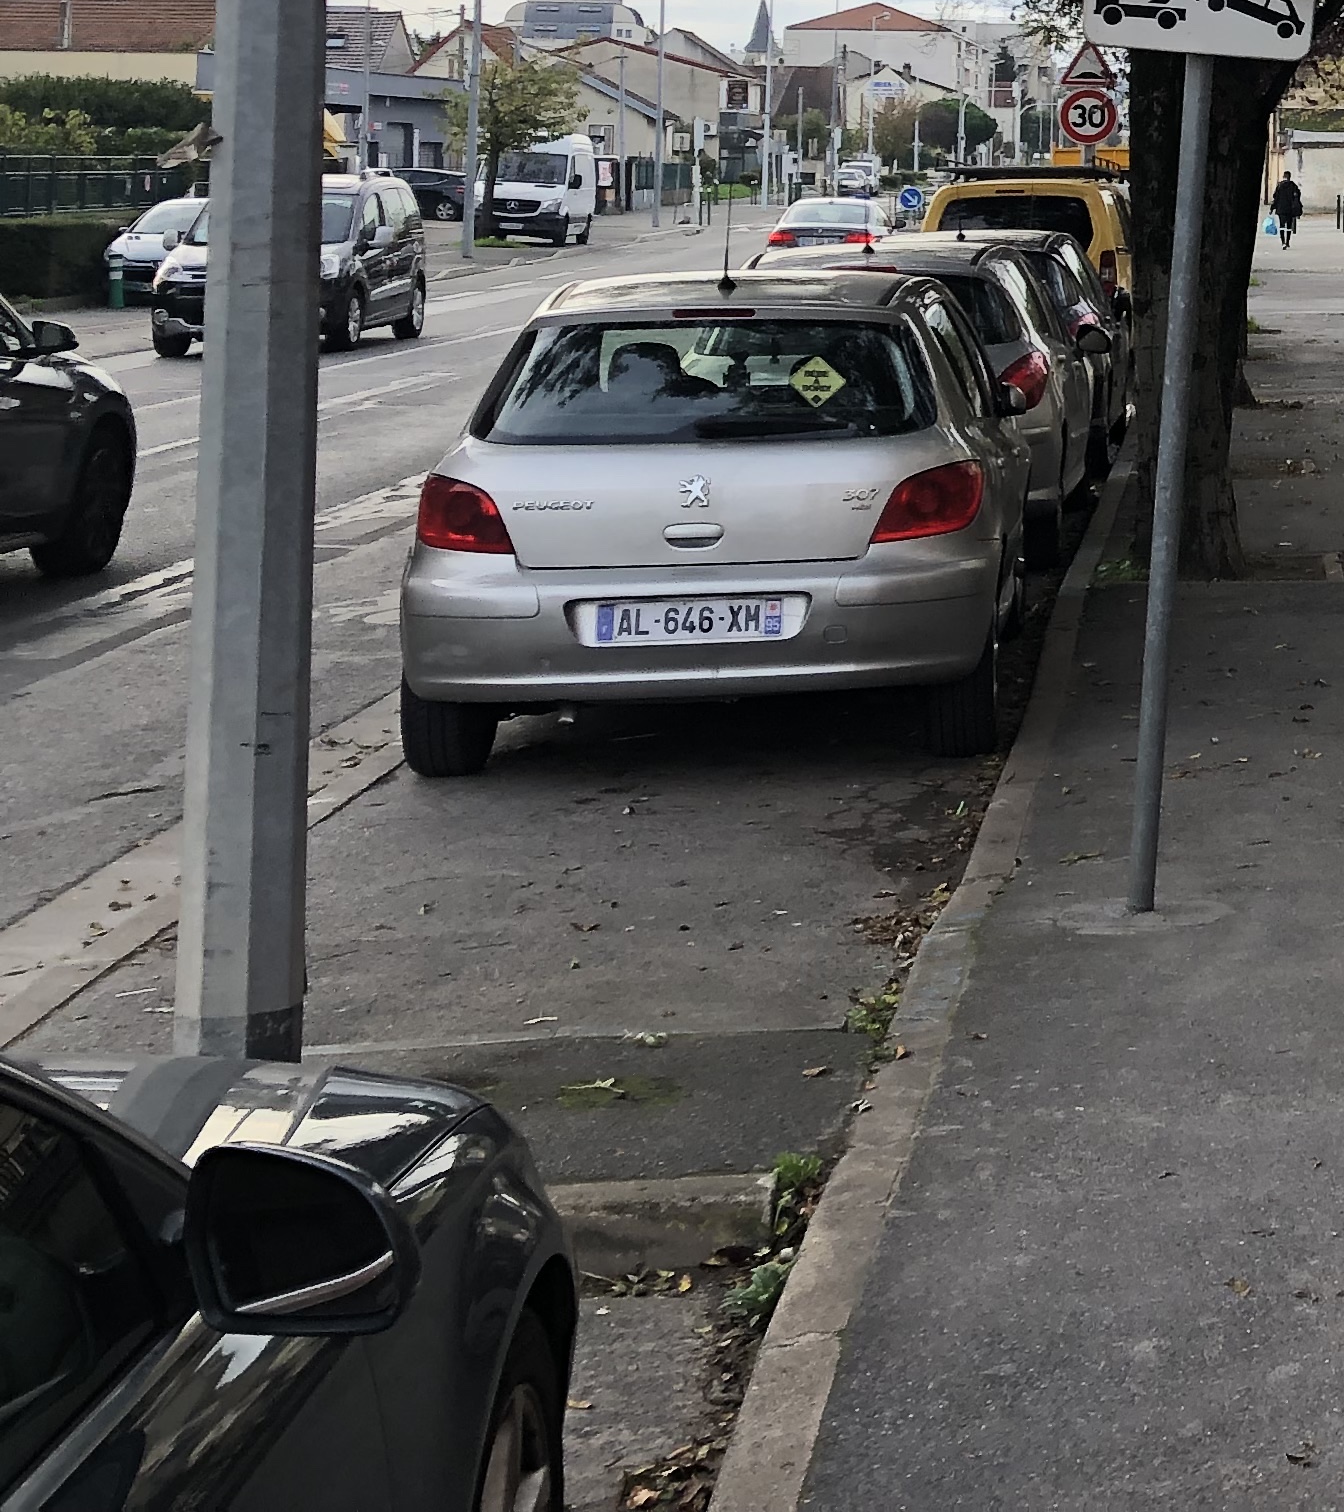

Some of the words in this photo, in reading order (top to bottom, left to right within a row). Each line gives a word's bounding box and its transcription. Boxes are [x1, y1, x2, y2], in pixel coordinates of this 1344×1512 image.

[1070, 104, 1105, 128] 30
[842, 488, 880, 502] 307
[512, 499, 594, 511] PEUGEOT
[617, 604, 761, 636] AL-646-XM
[765, 618, 780, 632] 95
